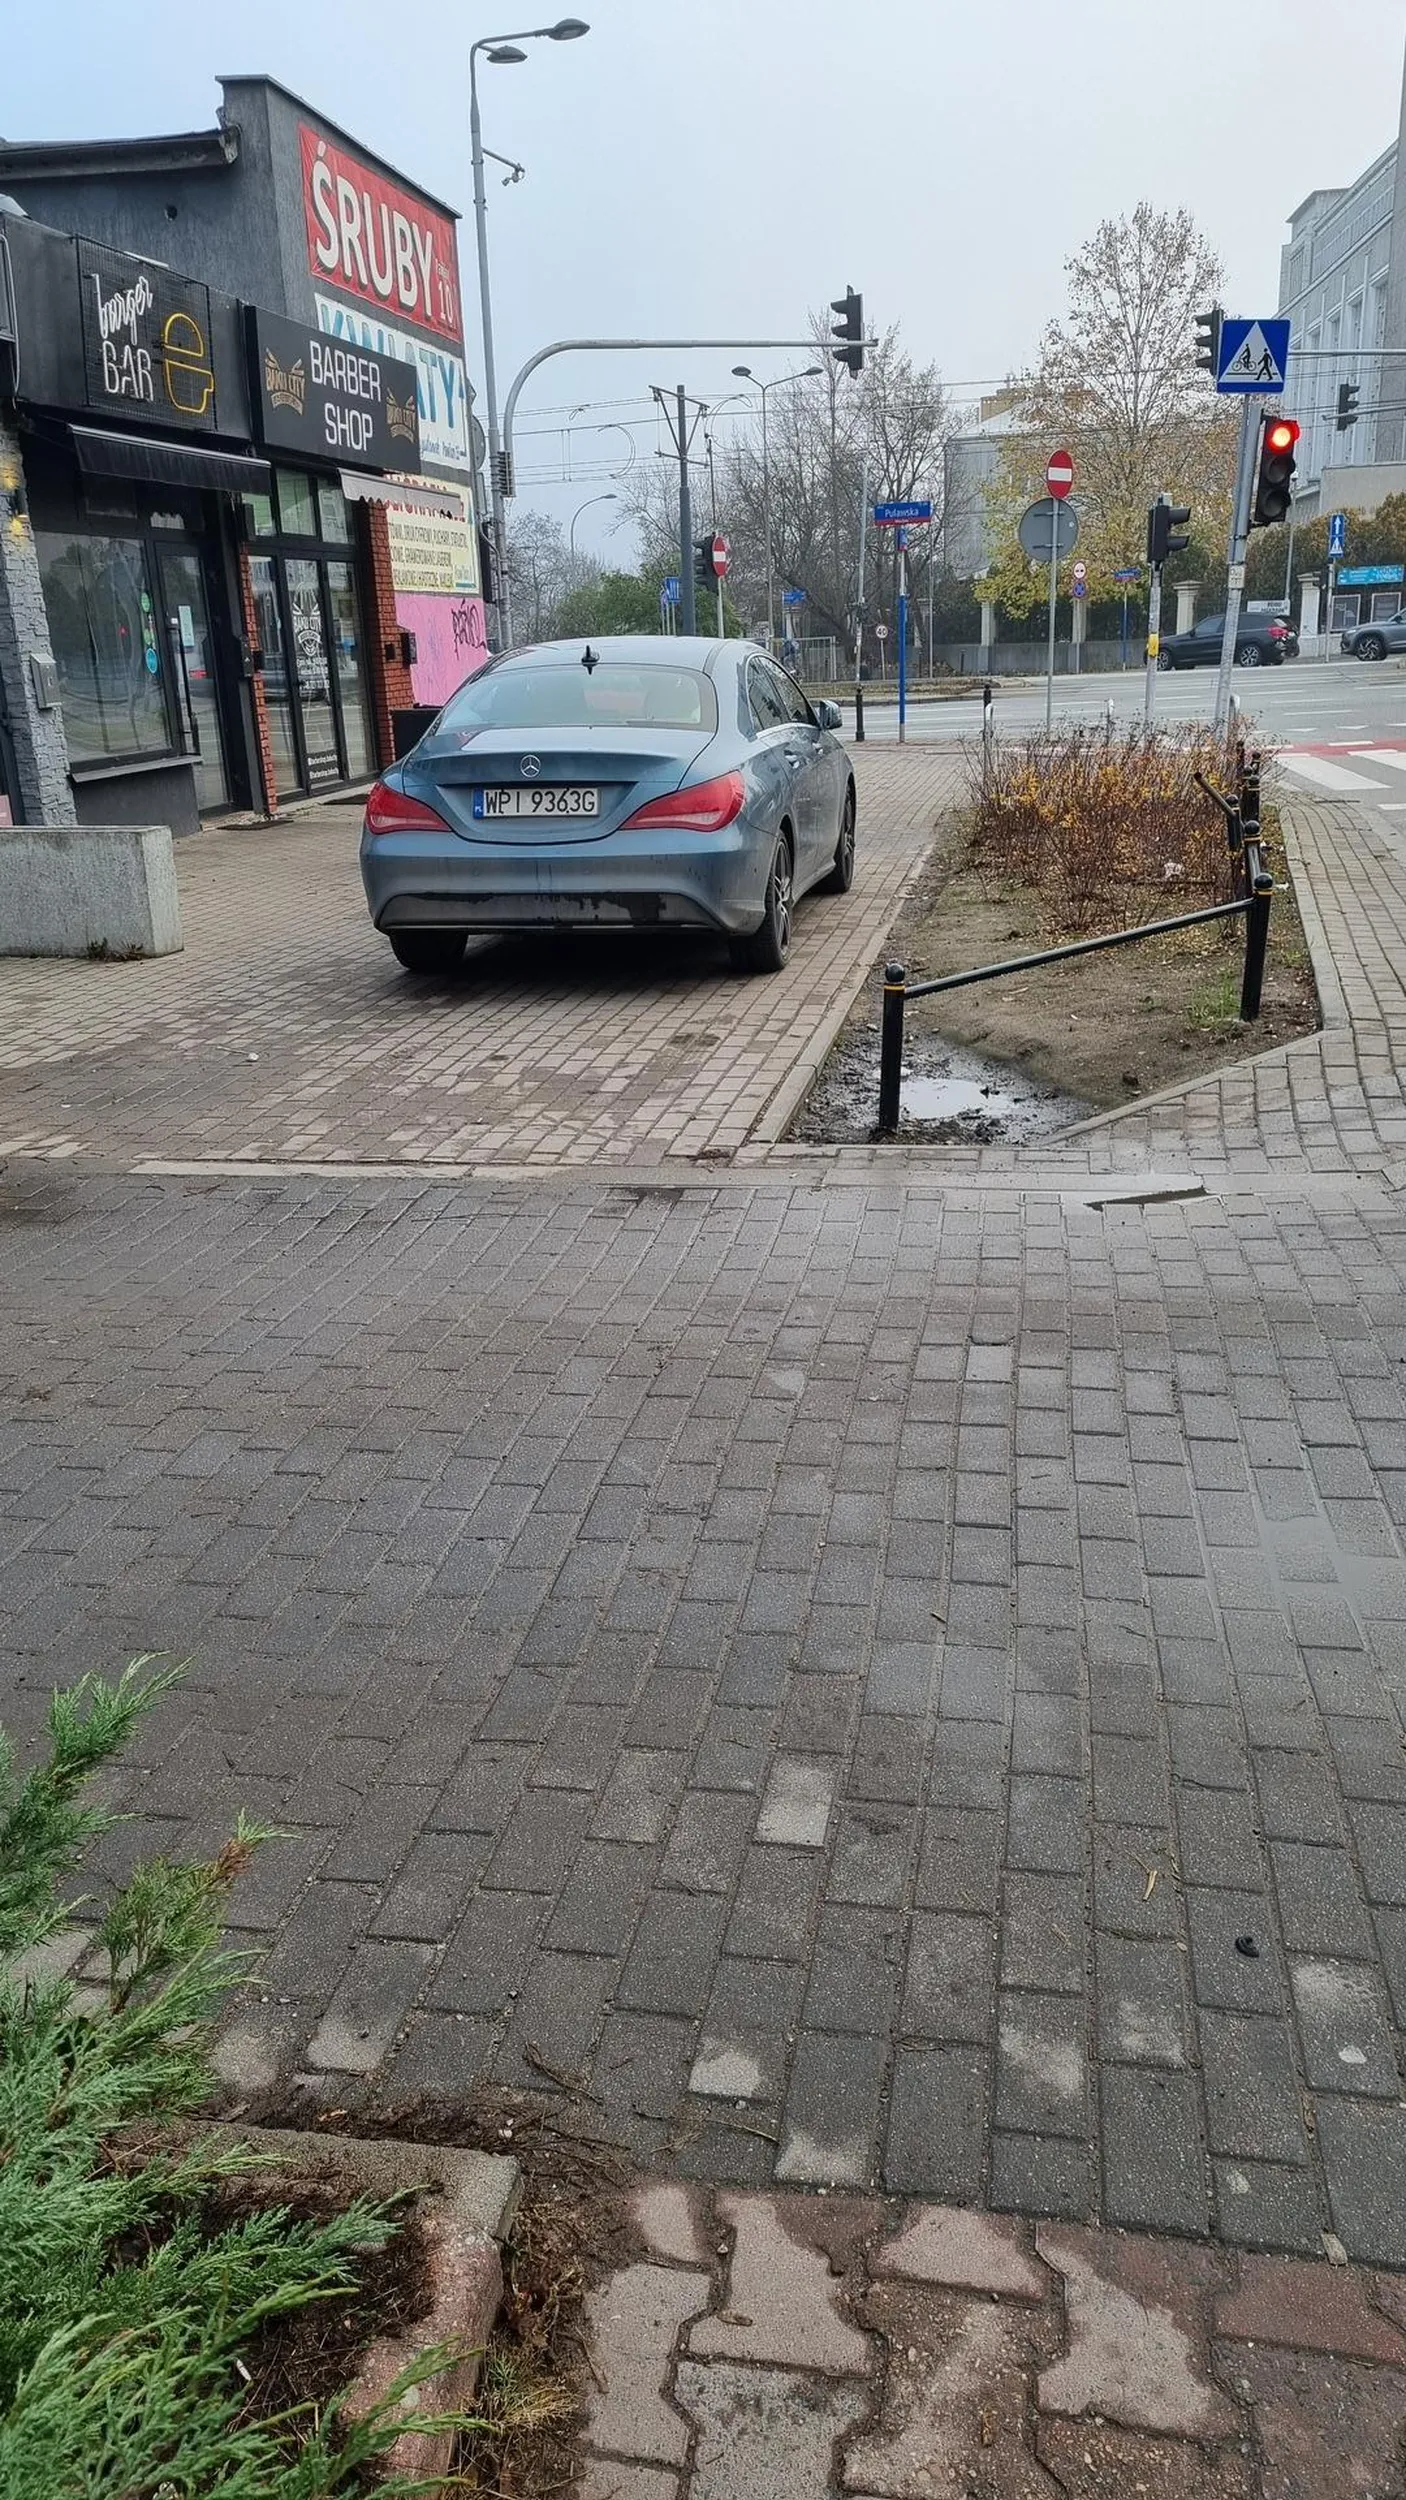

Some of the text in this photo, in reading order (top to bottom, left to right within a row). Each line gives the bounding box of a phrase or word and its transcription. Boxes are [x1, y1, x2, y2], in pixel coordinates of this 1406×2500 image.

[312, 140, 433, 318] ŚRUBY
[102, 340, 154, 401] BAR
[309, 340, 381, 402] BARBER
[324, 402, 374, 451] SHOP
[485, 789, 595, 814] WPI 9363G
